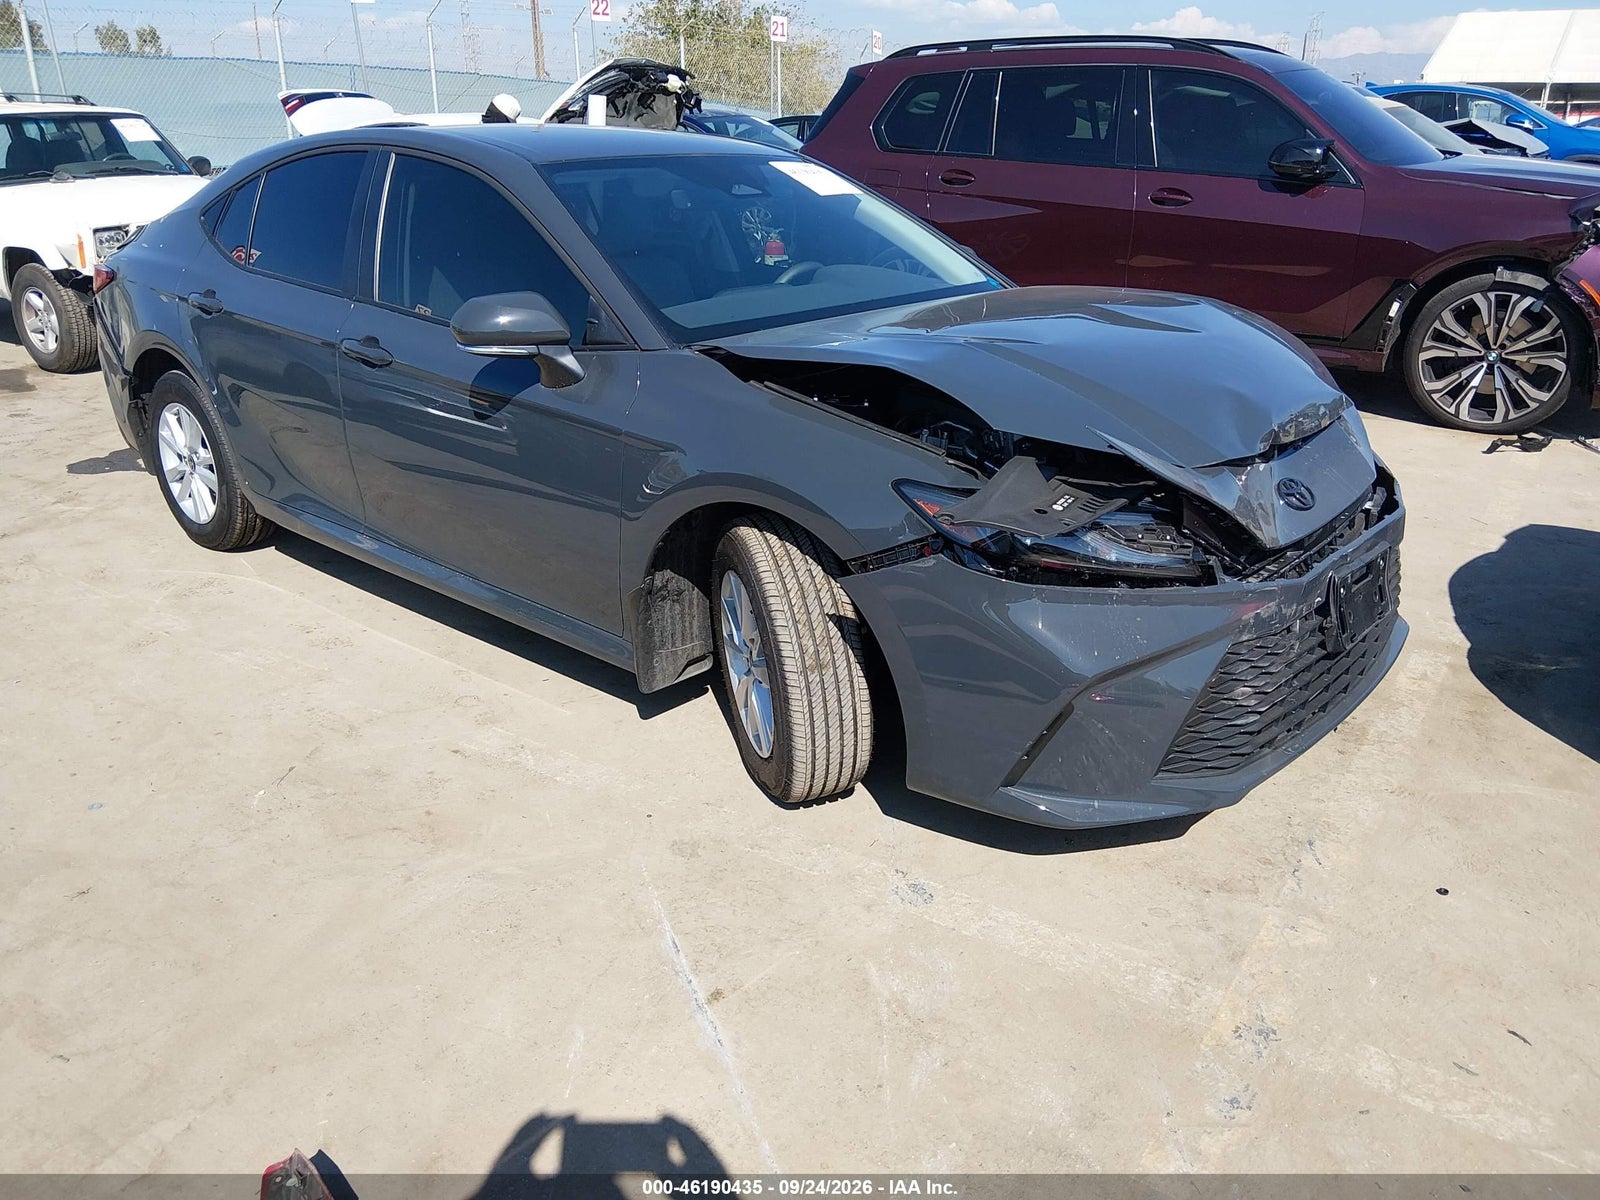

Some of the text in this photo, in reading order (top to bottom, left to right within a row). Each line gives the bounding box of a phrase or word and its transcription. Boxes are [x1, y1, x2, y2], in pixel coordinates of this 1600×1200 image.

[591, 0, 610, 16] 22
[772, 20, 786, 37] 21
[873, 34, 882, 50] 20
